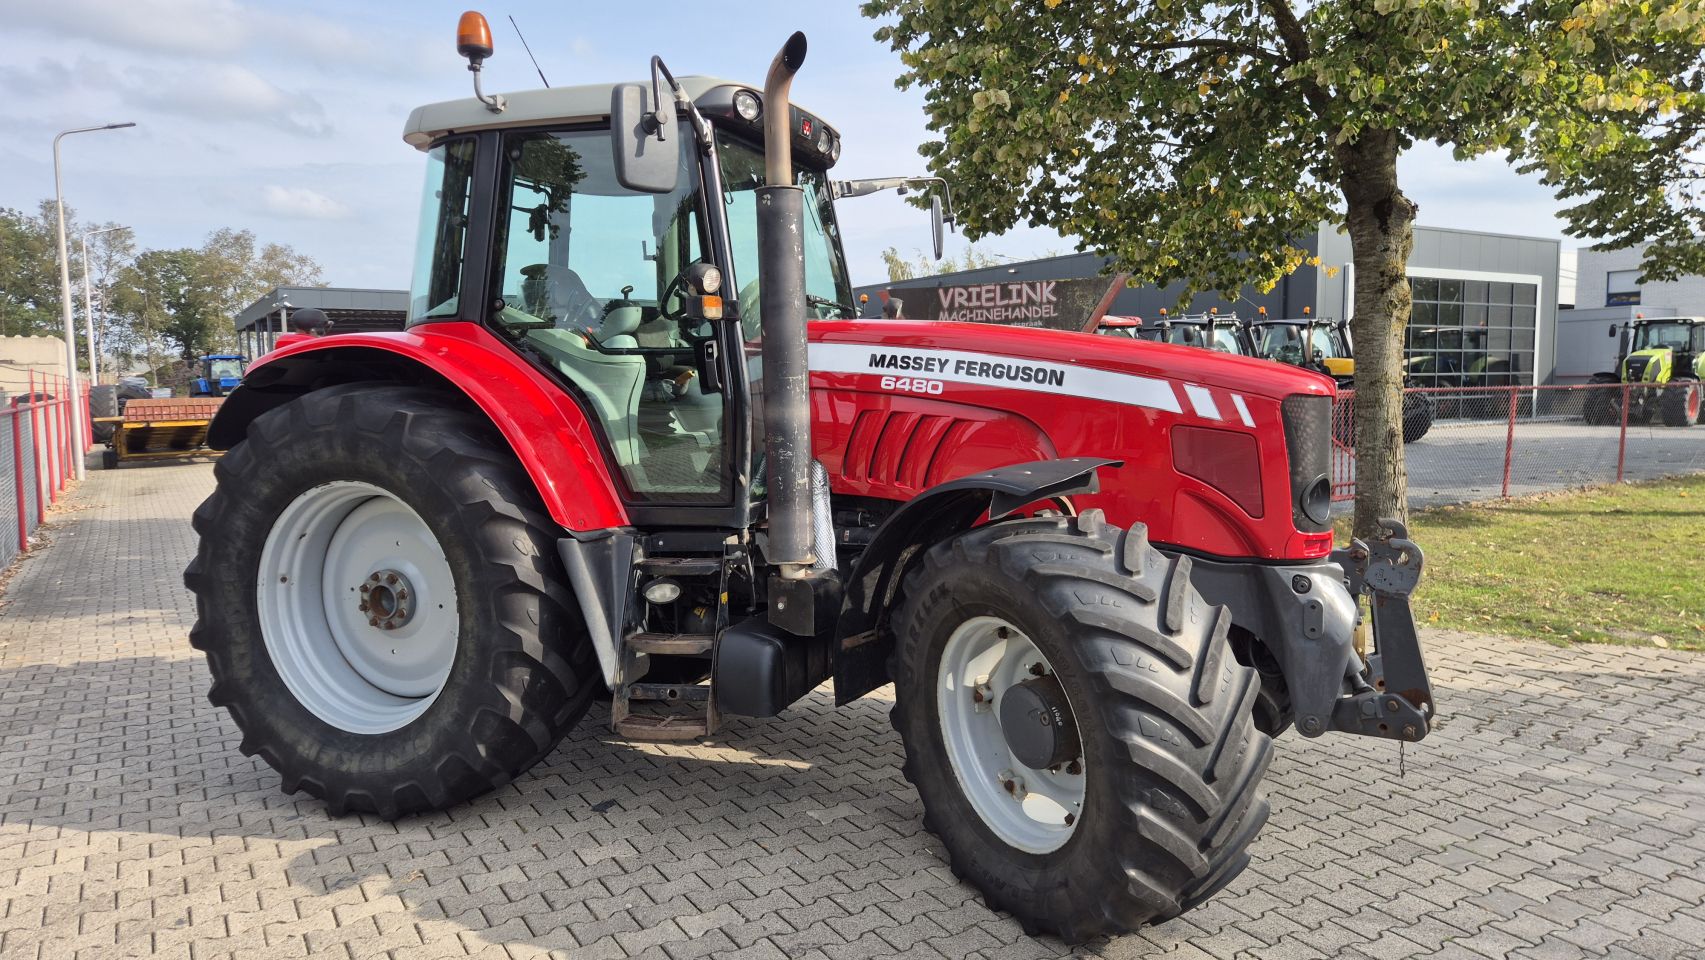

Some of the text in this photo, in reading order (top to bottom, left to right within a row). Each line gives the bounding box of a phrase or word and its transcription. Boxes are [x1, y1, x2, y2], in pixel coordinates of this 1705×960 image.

[938, 281, 1057, 308] VRIELINK
[938, 305, 1059, 321] MACHINEHANDEL
[868, 353, 1065, 387] MASSEY FERGUSON
[880, 376, 944, 395] 6480
